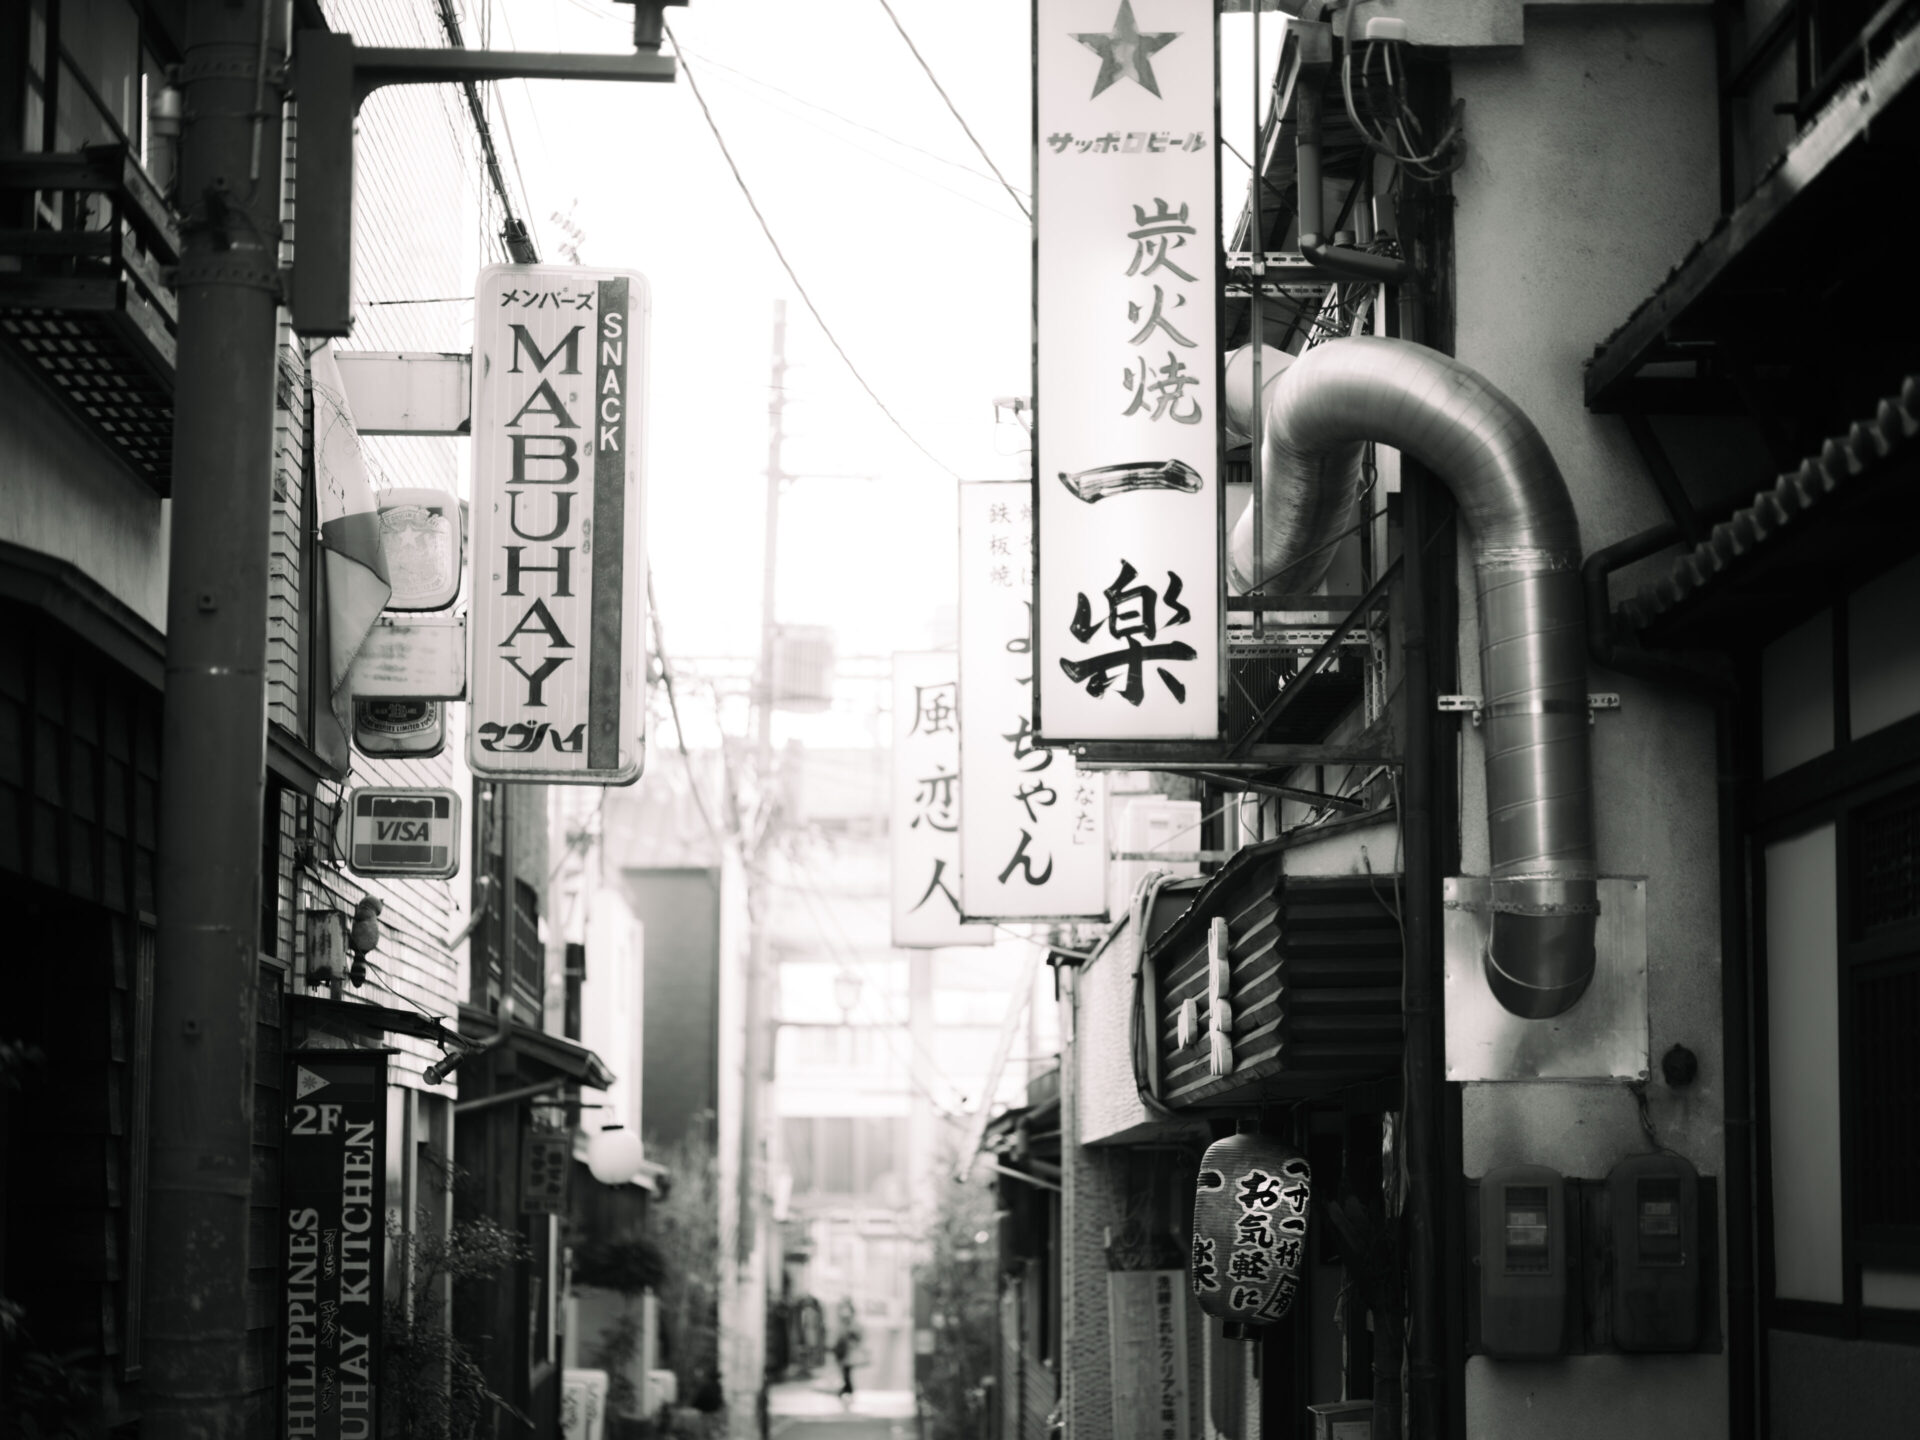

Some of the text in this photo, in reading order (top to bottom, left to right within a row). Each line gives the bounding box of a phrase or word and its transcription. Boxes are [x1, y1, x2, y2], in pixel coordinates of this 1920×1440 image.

[1046, 131, 1208, 154] サッポロビール
[500, 287, 595, 311] メンバーズ
[600, 312, 623, 451] SNACK
[1121, 197, 1202, 425] 炭火焼
[497, 323, 586, 708] MABUHAY
[1057, 458, 1204, 707] 一楽
[478, 719, 588, 754] マブハイ
[907, 682, 962, 914] 風恋人
[998, 600, 1057, 886] よちゃん
[376, 821, 429, 842] VISA
[291, 1104, 343, 1135] 2F
[340, 1119, 375, 1306] KITCHEN
[1226, 1168, 1284, 1311] お気軽に
[287, 1207, 319, 1440] HILIPPINES
